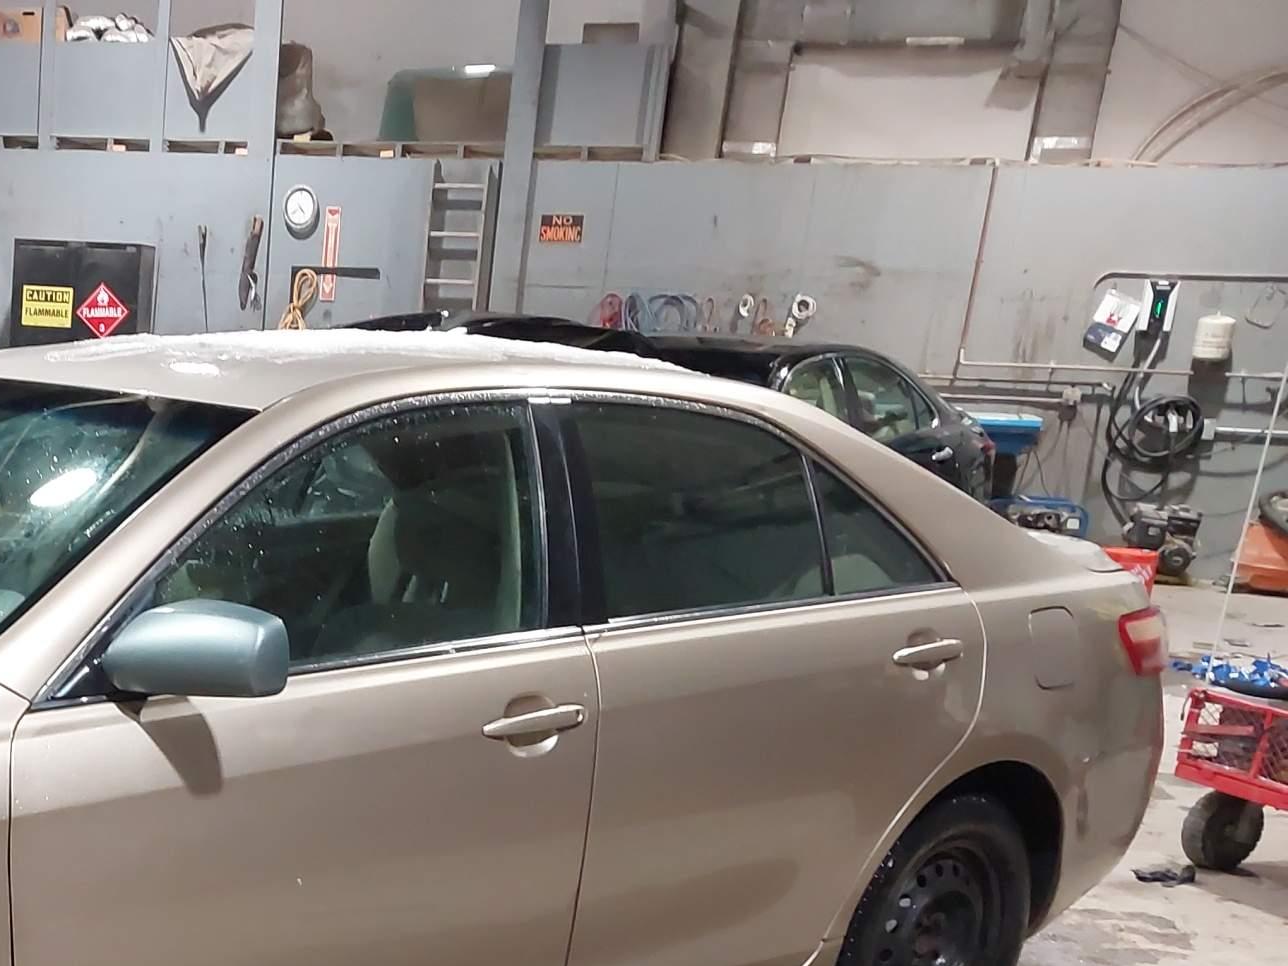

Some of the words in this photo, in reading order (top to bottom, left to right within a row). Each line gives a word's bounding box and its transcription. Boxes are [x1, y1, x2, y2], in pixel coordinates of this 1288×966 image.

[552, 215, 573, 225] NO
[540, 225, 581, 241] SMOKING
[26, 289, 70, 303] CAUTION
[25, 306, 69, 318] FLAMMABLE
[82, 306, 122, 318] FLAMMABLE
